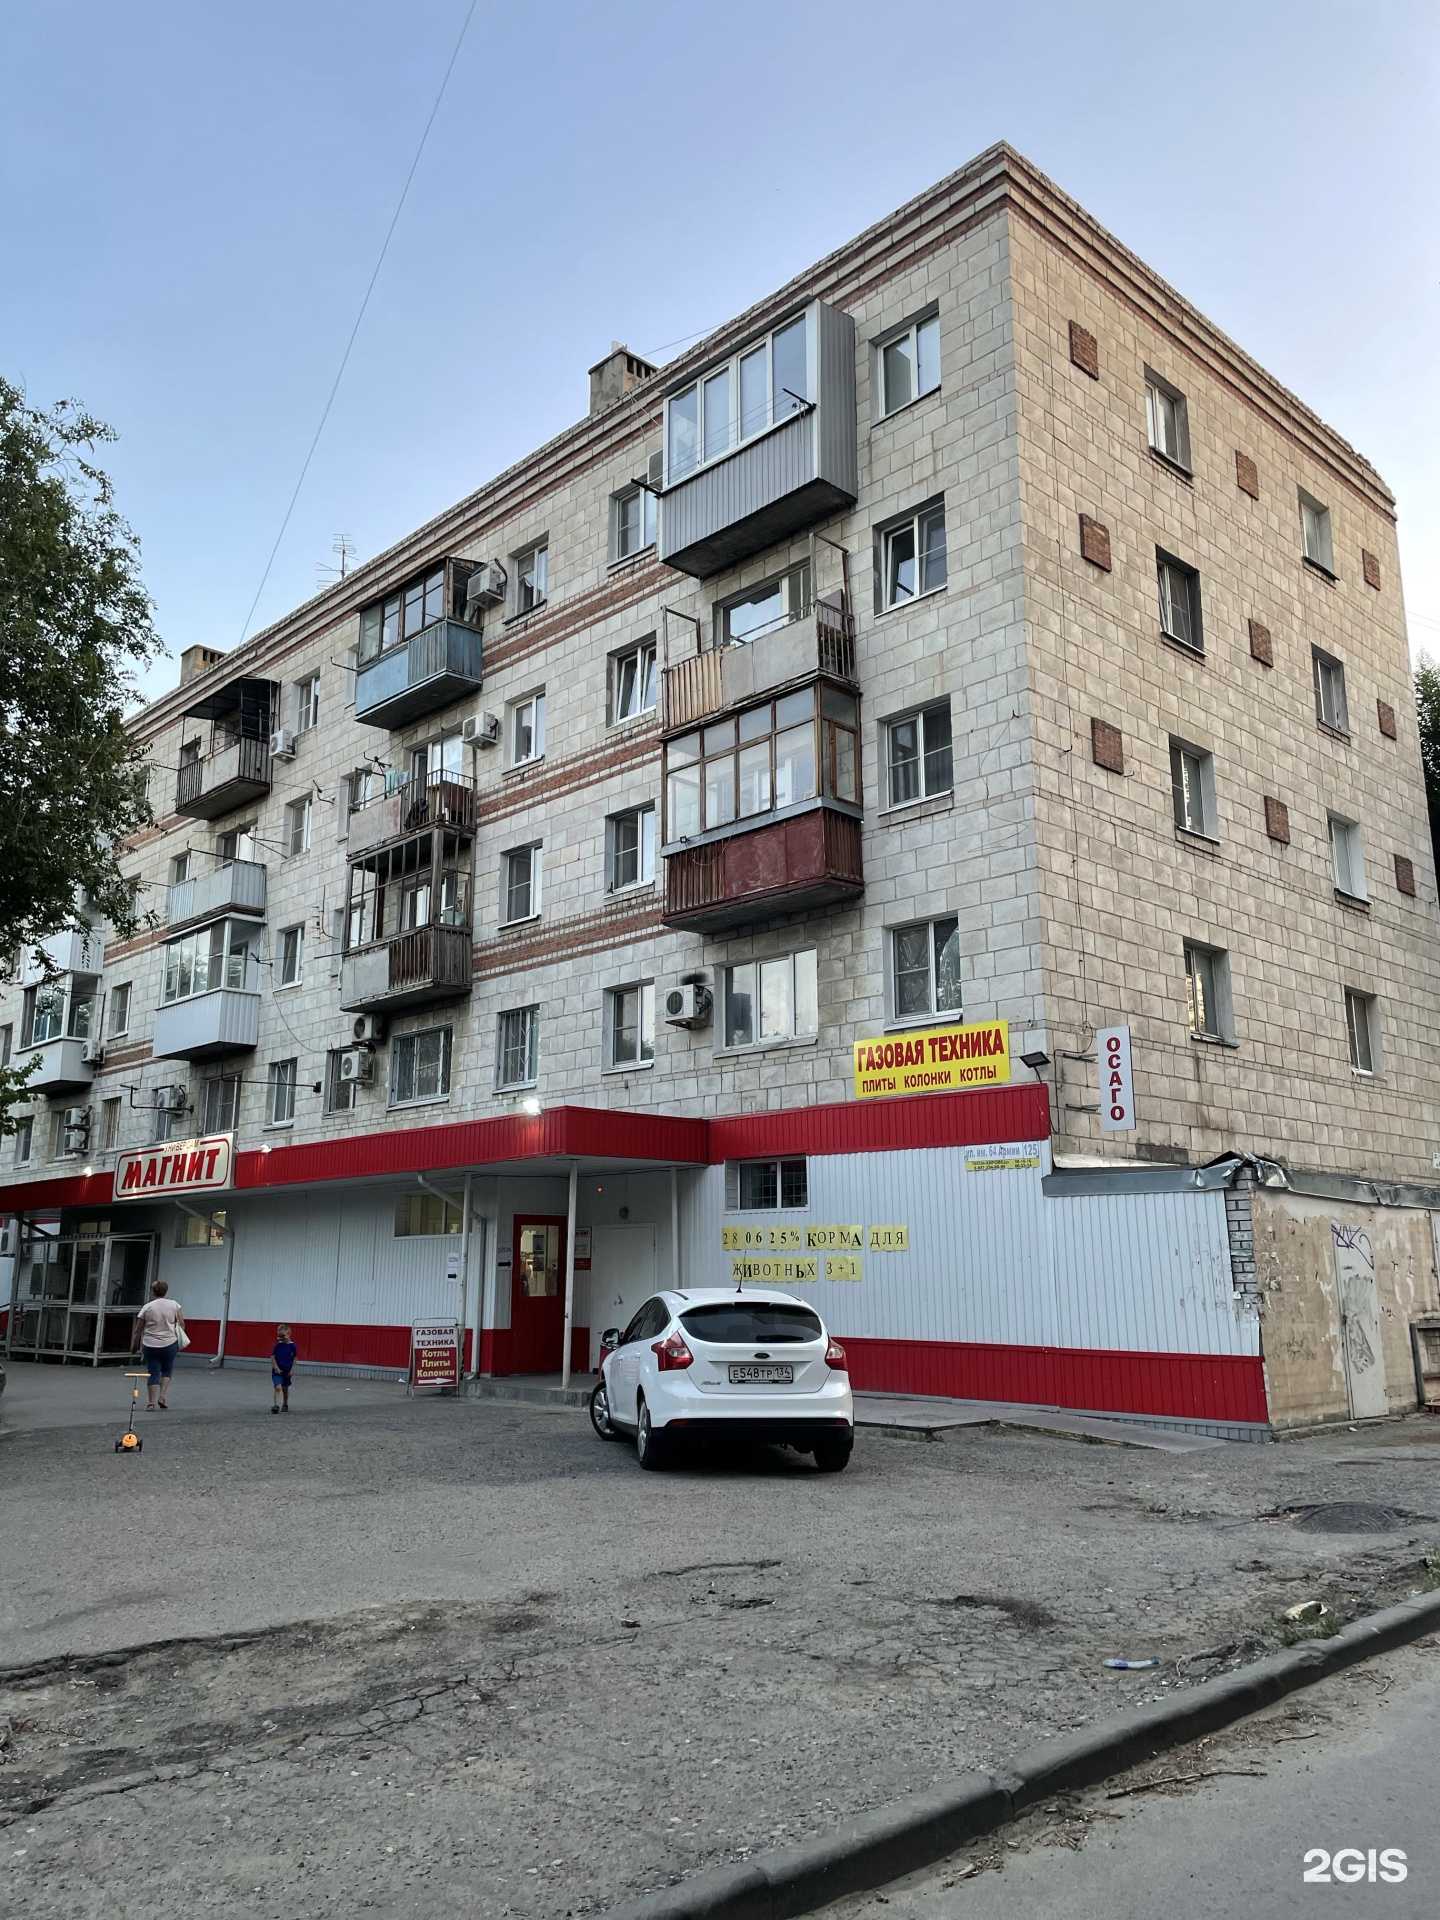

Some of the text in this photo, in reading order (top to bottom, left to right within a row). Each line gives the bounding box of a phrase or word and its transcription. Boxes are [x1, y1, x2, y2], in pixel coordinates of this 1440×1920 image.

[858, 1029, 1004, 1072] ГАЗОВАЯ ТЕХНИКА
[862, 1065, 997, 1093] ПЛИТЫ КОЛОНКИ КОТЛЫ
[1106, 1037, 1125, 1121] ОСАГО
[1024, 1144, 1037, 1156] 125
[122, 1148, 220, 1189] МАГНИТ
[807, 1231, 862, 1247] КОРМА
[870, 1231, 905, 1248] ДЛЯ
[733, 1262, 815, 1279] ЖИВОТНЫХ
[416, 1339, 455, 1347] ТЕХНИКА
[421, 1360, 450, 1368] Плиты
[417, 1369, 455, 1377] Колонки
